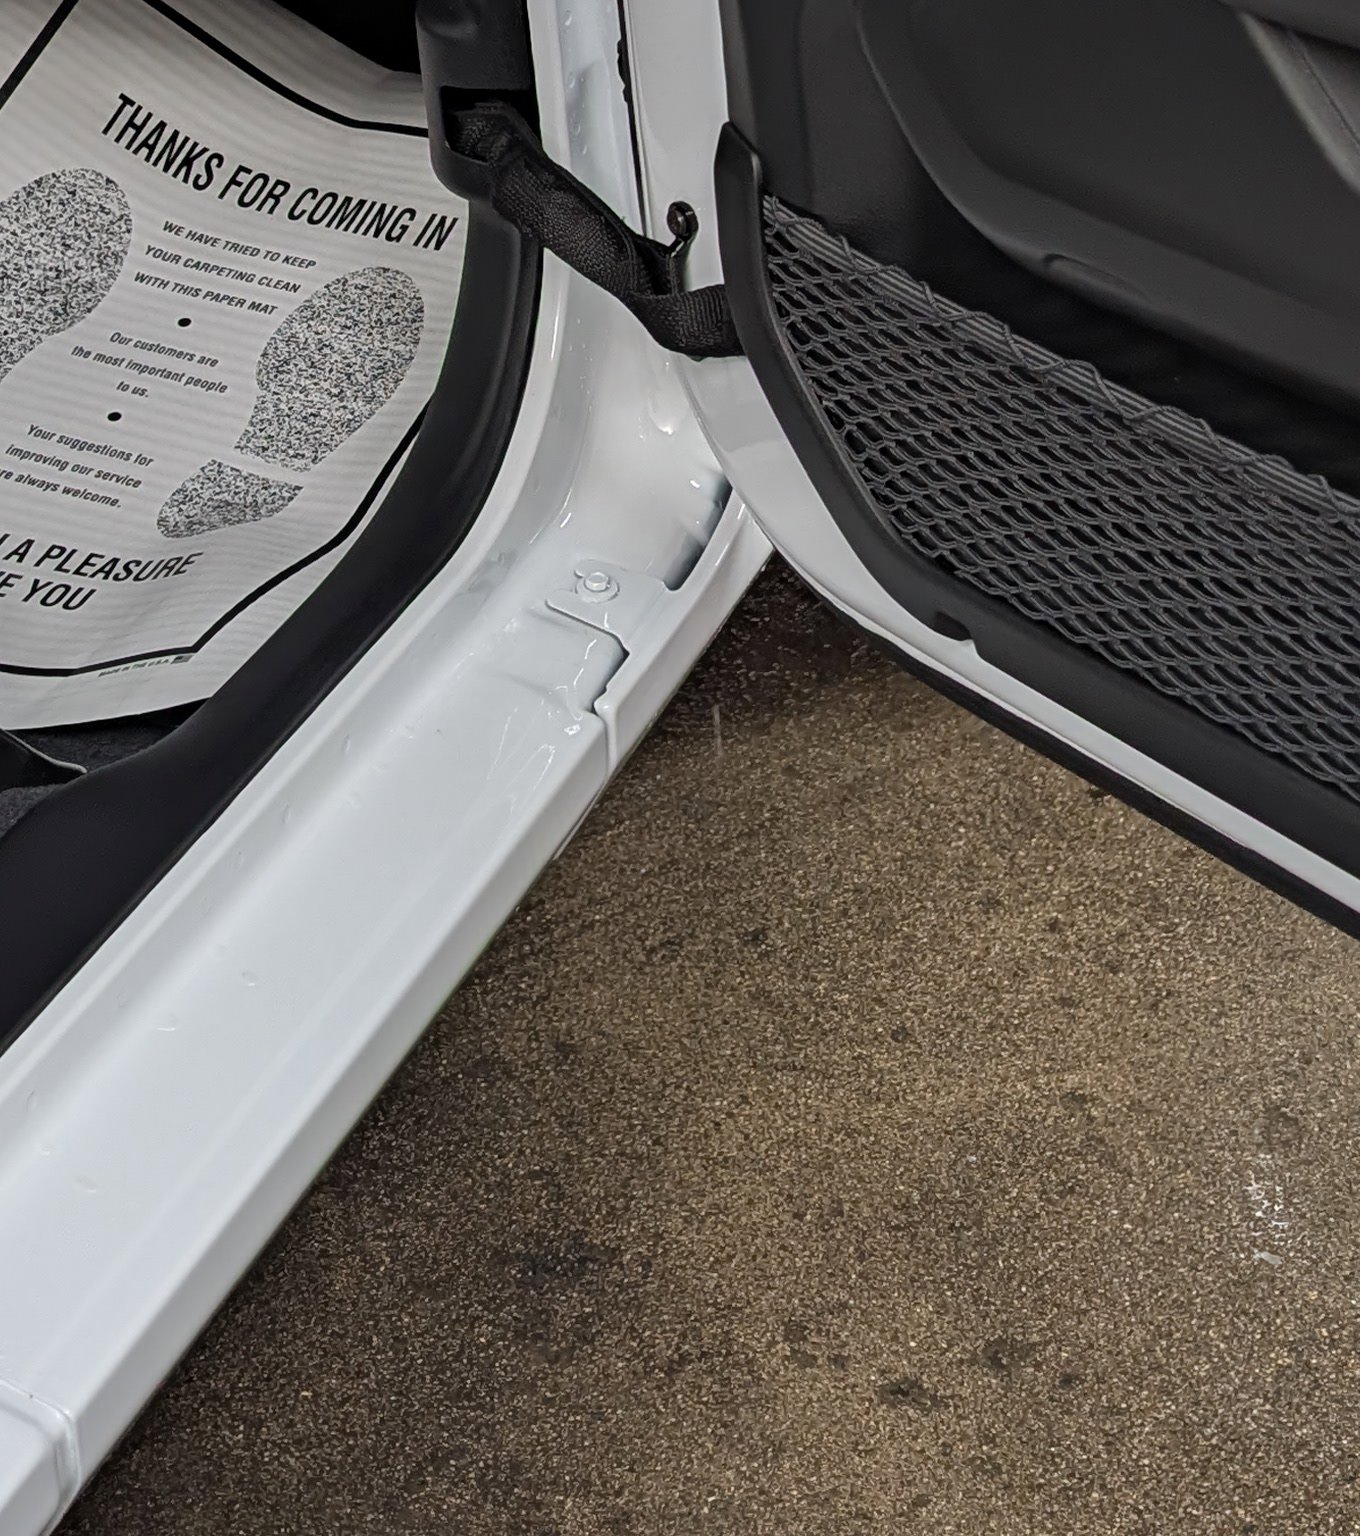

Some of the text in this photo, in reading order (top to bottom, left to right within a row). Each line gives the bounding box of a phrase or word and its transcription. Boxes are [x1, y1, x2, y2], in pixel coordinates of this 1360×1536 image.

[101, 92, 459, 252] THANKS FOR COMING IN
[163, 220, 317, 270] WE HAVE TRIED TO KEEP
[144, 245, 301, 294] YOUR CARPETING CLEAN
[134, 271, 278, 315] WITH THIS PAPER MAT
[71, 346, 228, 394] the most important people
[110, 332, 219, 367] Our customers are
[116, 380, 149, 398] to us.
[5, 444, 142, 488] improving our service
[27, 424, 154, 467] Your suggestions for
[14, 473, 60, 492] always
[61, 485, 121, 509] welcome.
[3, 538, 35, 563] A
[33, 544, 203, 583] PLEASURE
[22, 578, 97, 611] YOU
